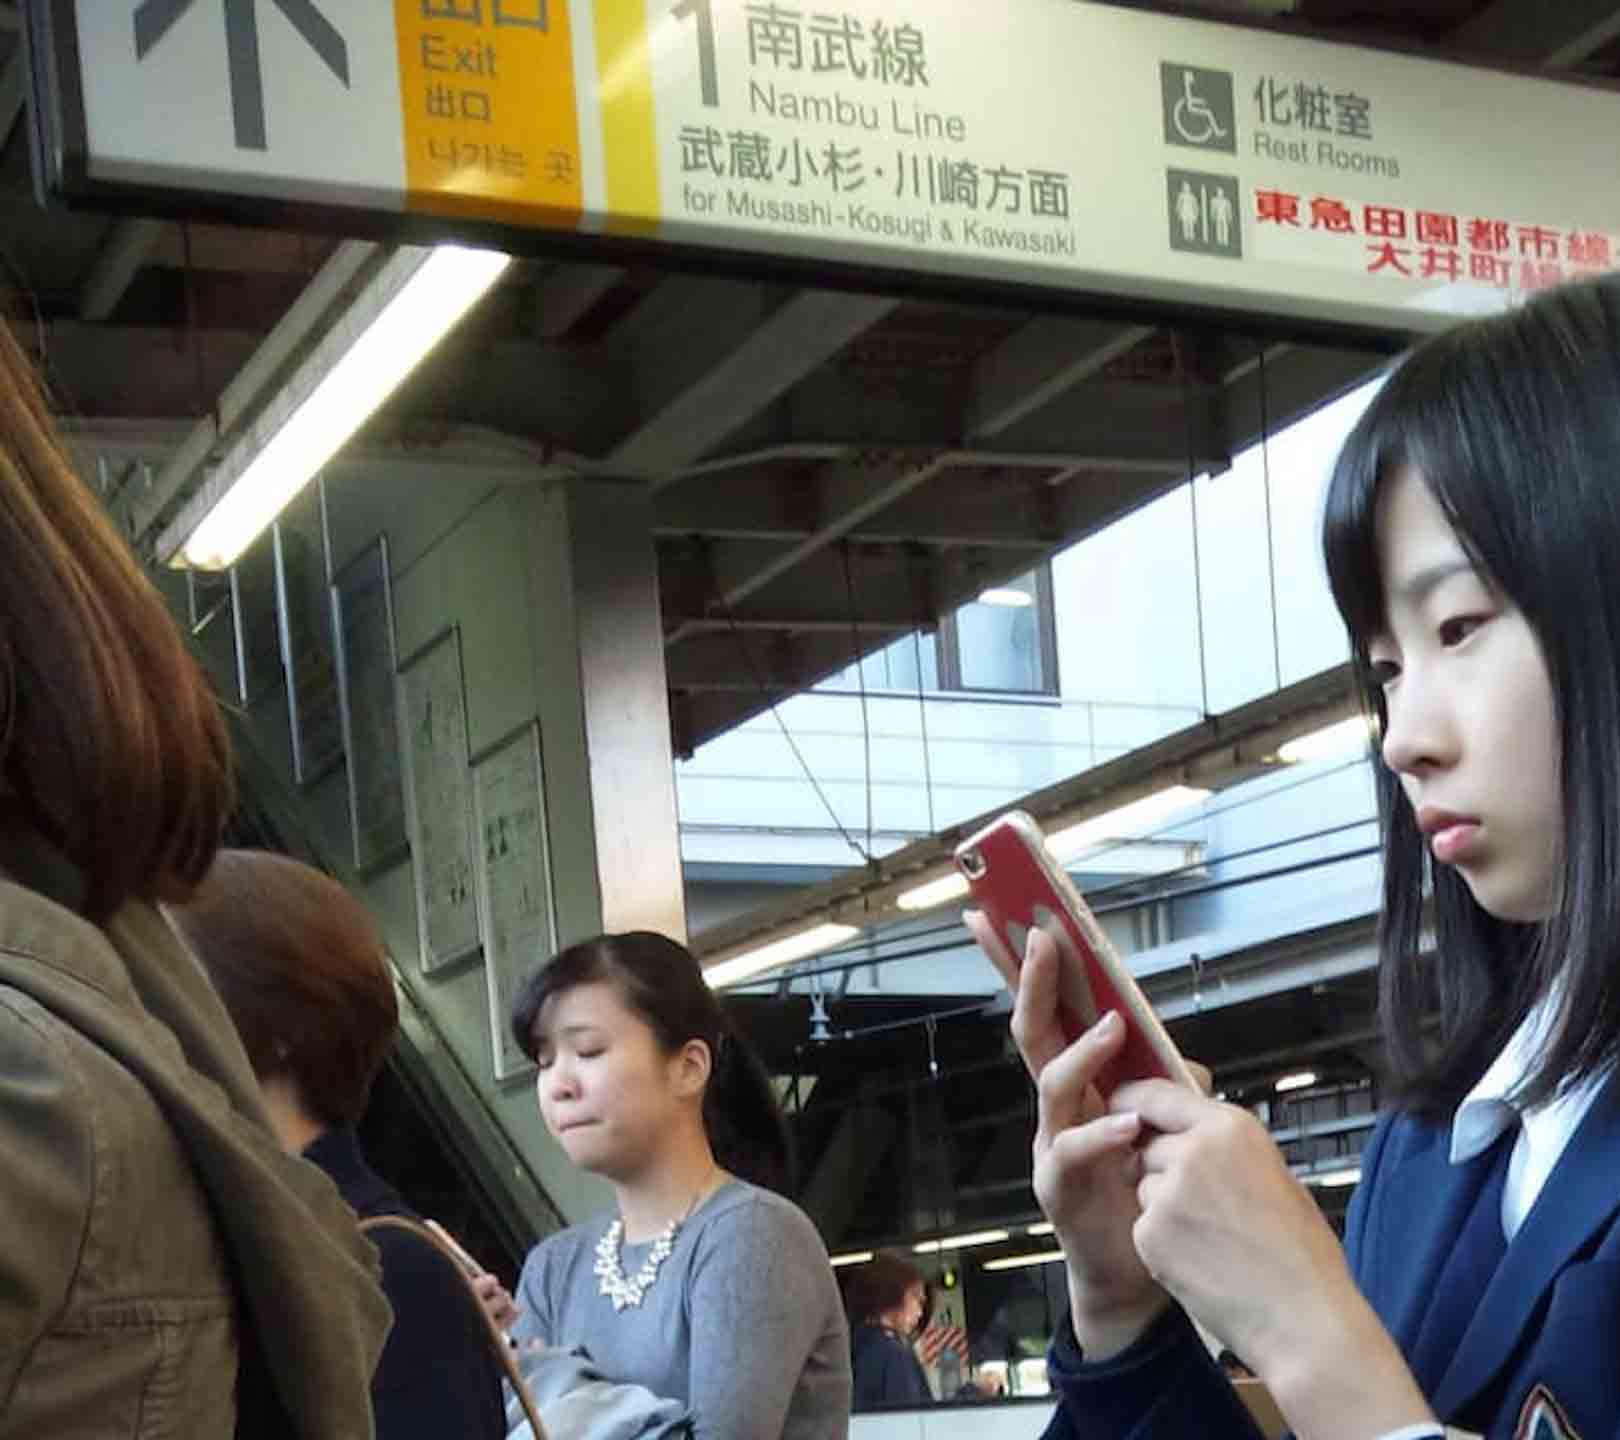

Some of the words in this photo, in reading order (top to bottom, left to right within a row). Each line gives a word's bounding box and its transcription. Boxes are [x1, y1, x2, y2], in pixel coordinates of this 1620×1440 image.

[421, 34, 496, 77] Exit
[745, 4, 929, 86] 南武線
[426, 82, 491, 121] 出口
[749, 80, 879, 130] Nambu
[893, 98, 966, 143] Line
[1254, 74, 1373, 141] 化粧室
[429, 139, 524, 177] 나가는
[1254, 132, 1308, 164] Rest
[1317, 142, 1400, 177] Rooms
[684, 185, 717, 212] for
[728, 190, 932, 243] Musashi-Kosugi
[941, 225, 953, 241] &
[963, 219, 1076, 256] Kawasaki
